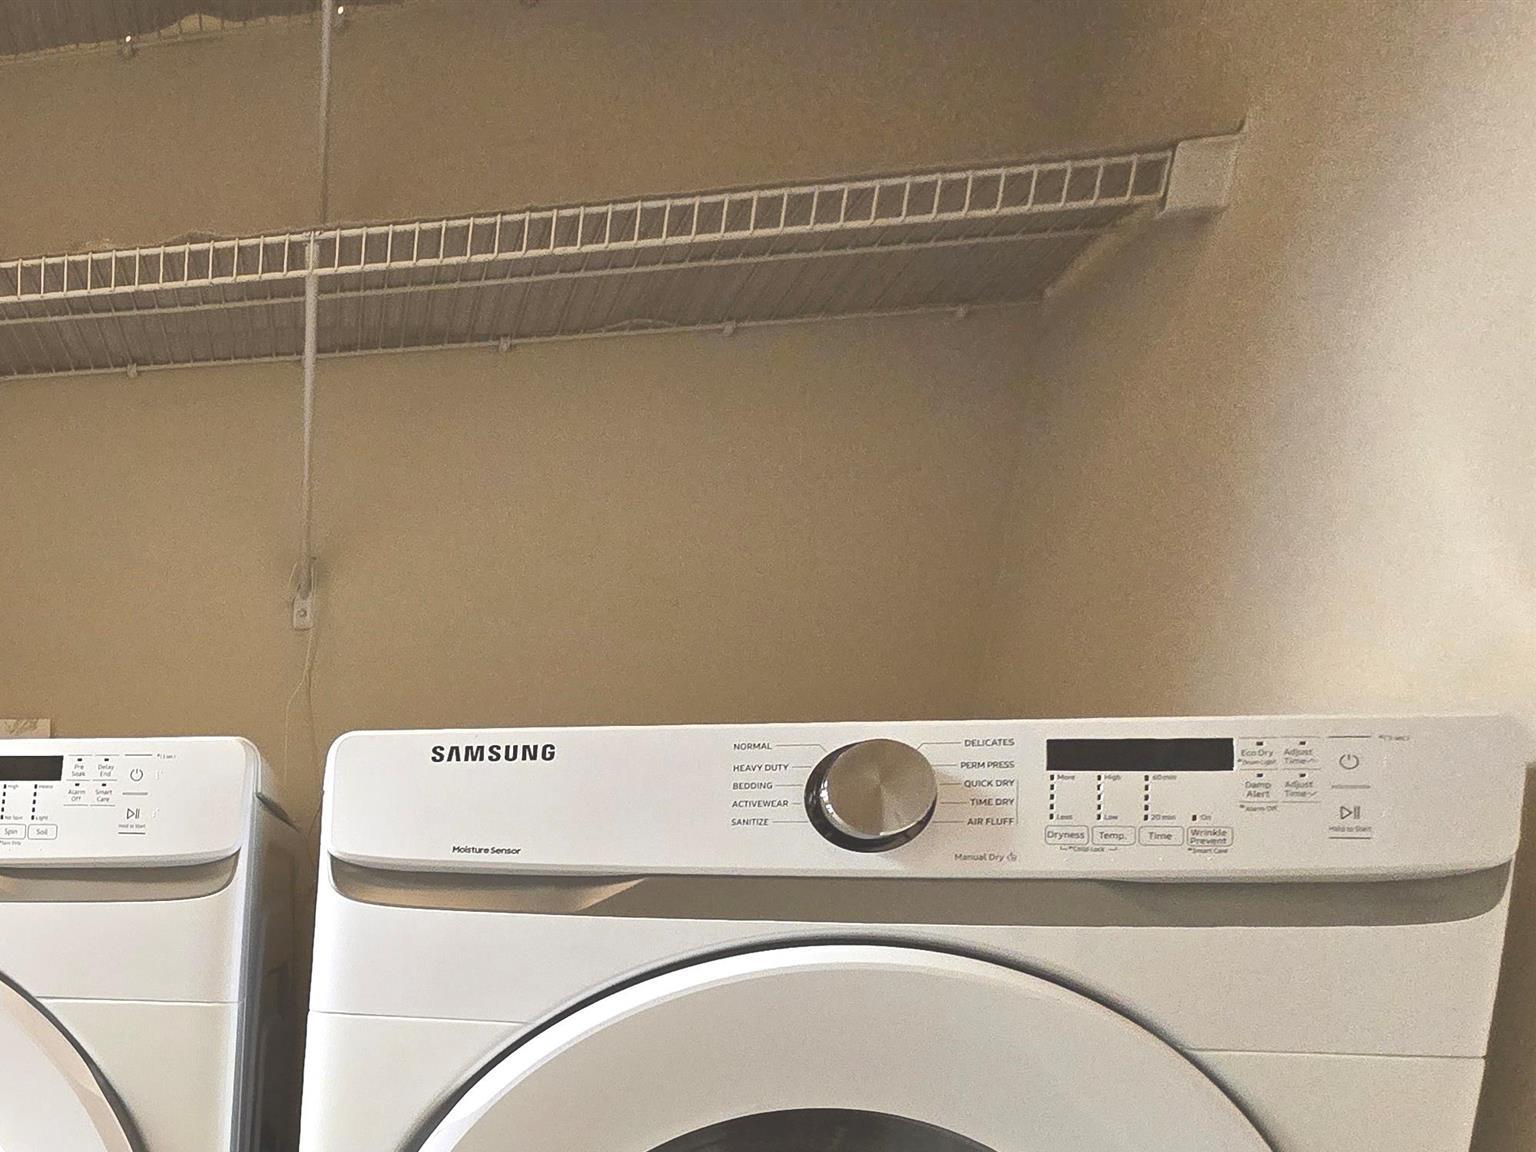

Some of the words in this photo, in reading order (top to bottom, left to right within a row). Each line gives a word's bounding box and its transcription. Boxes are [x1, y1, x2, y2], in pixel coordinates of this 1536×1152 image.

[733, 742, 772, 750] NORMAL
[964, 738, 1015, 747] DELICATES
[431, 744, 556, 763] SAMSUNG
[1257, 749, 1273, 757] Dry
[1284, 748, 1313, 756] Adjust
[98, 763, 115, 771] Delay
[733, 764, 763, 772] HEAVY
[764, 763, 789, 772] DUTY
[960, 761, 985, 769] PERM
[987, 761, 1015, 769] PRESS
[100, 770, 112, 778] End
[732, 782, 773, 790] BEDDING
[964, 780, 993, 788] QUICK
[1245, 781, 1272, 790] Damp
[1284, 780, 1313, 789] Adjust
[1247, 790, 1270, 798] Alert
[732, 800, 789, 808] ACTIVEWEAR
[969, 798, 993, 806] TIME
[995, 798, 1014, 806] DRY
[731, 818, 769, 826] SANITIZE
[967, 818, 983, 826] AIR
[5, 827, 18, 837] Spin
[36, 828, 49, 836] Soil
[1047, 830, 1085, 840] Dryness
[1148, 831, 1173, 840] Time
[1190, 829, 1227, 837] Wrinkle
[452, 846, 490, 854] Moisture
[490, 847, 521, 855] Sensor
[954, 853, 986, 861] Manual
[989, 853, 1004, 862] Dry
